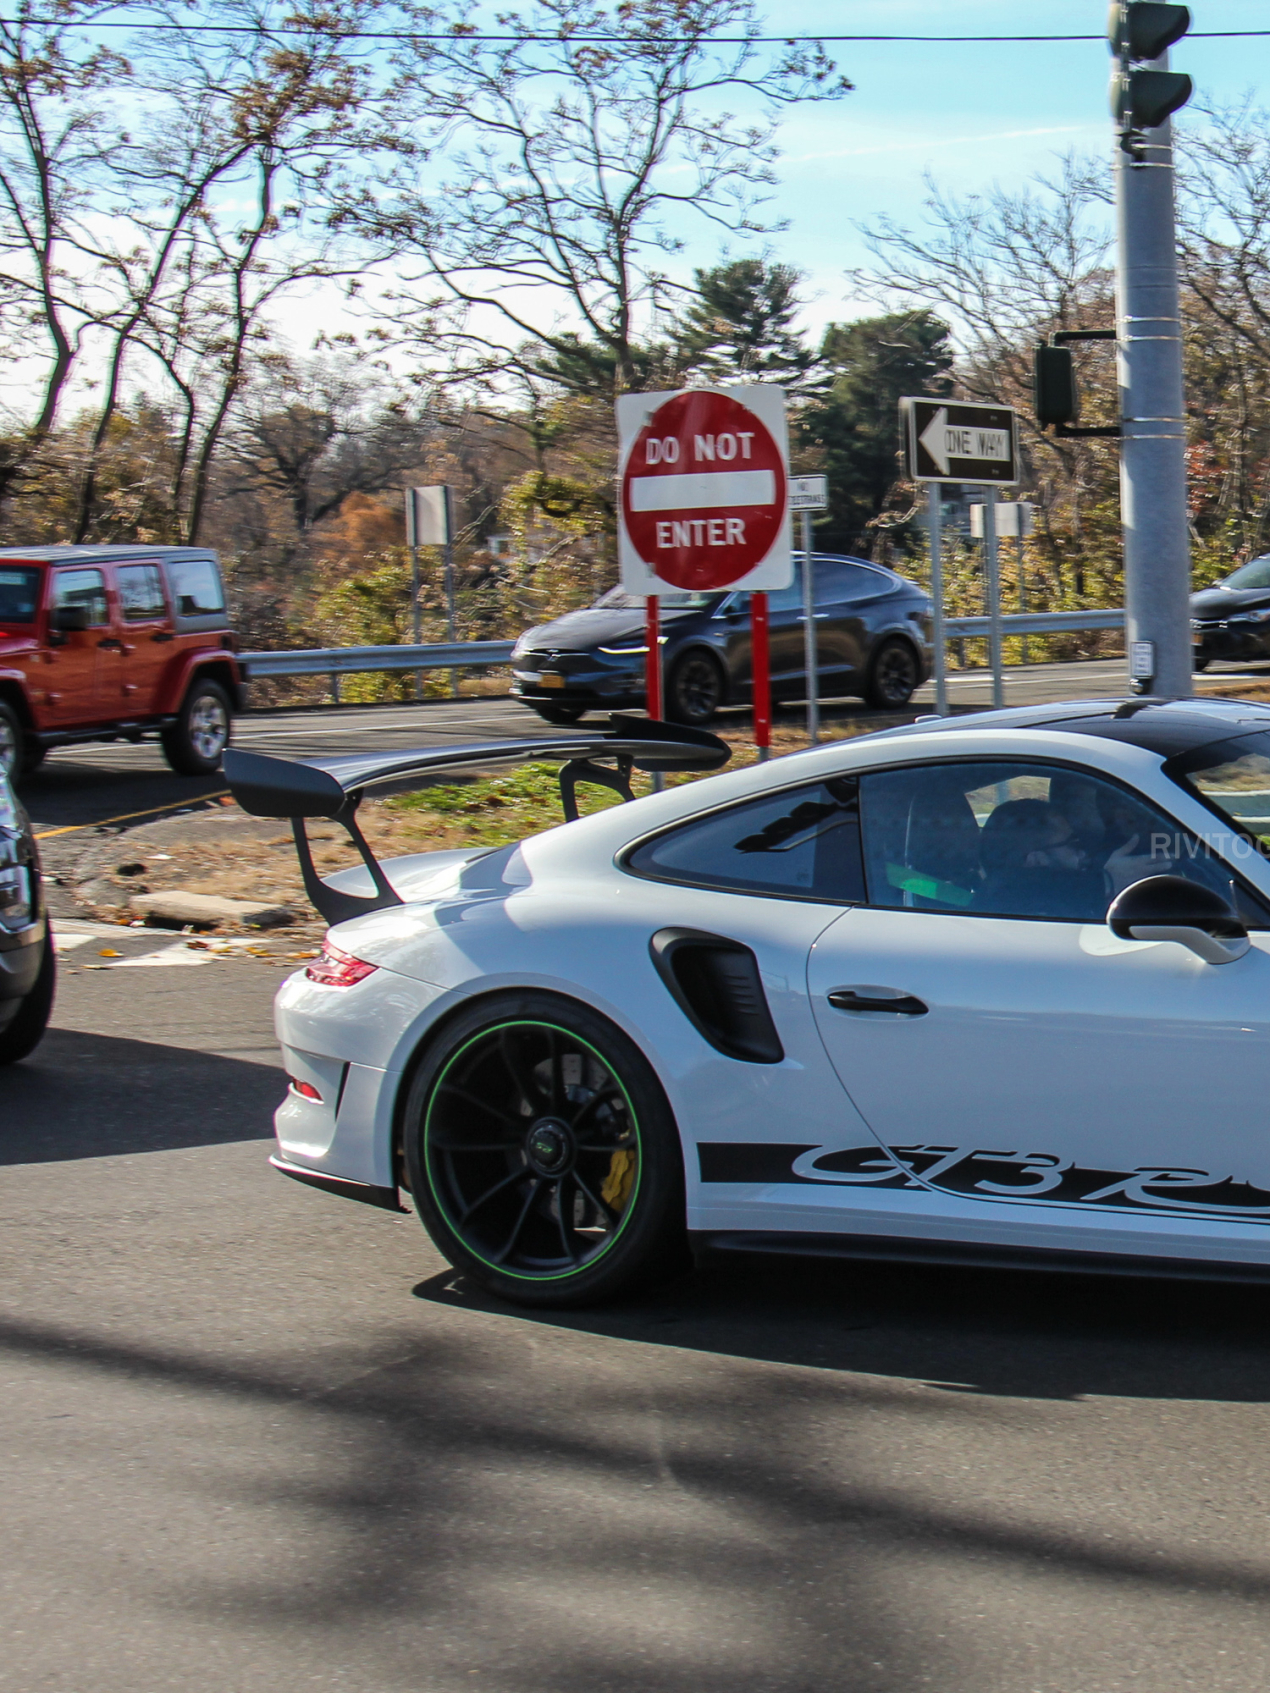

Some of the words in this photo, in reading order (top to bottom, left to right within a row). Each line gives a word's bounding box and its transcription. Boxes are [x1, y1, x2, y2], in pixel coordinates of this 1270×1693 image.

[645, 436, 680, 465] DO
[694, 431, 755, 462] NOT
[944, 428, 972, 455] ONE
[977, 432, 1006, 457] WAY
[656, 518, 747, 548] ENTER
[791, 1145, 1074, 1195] GT3
